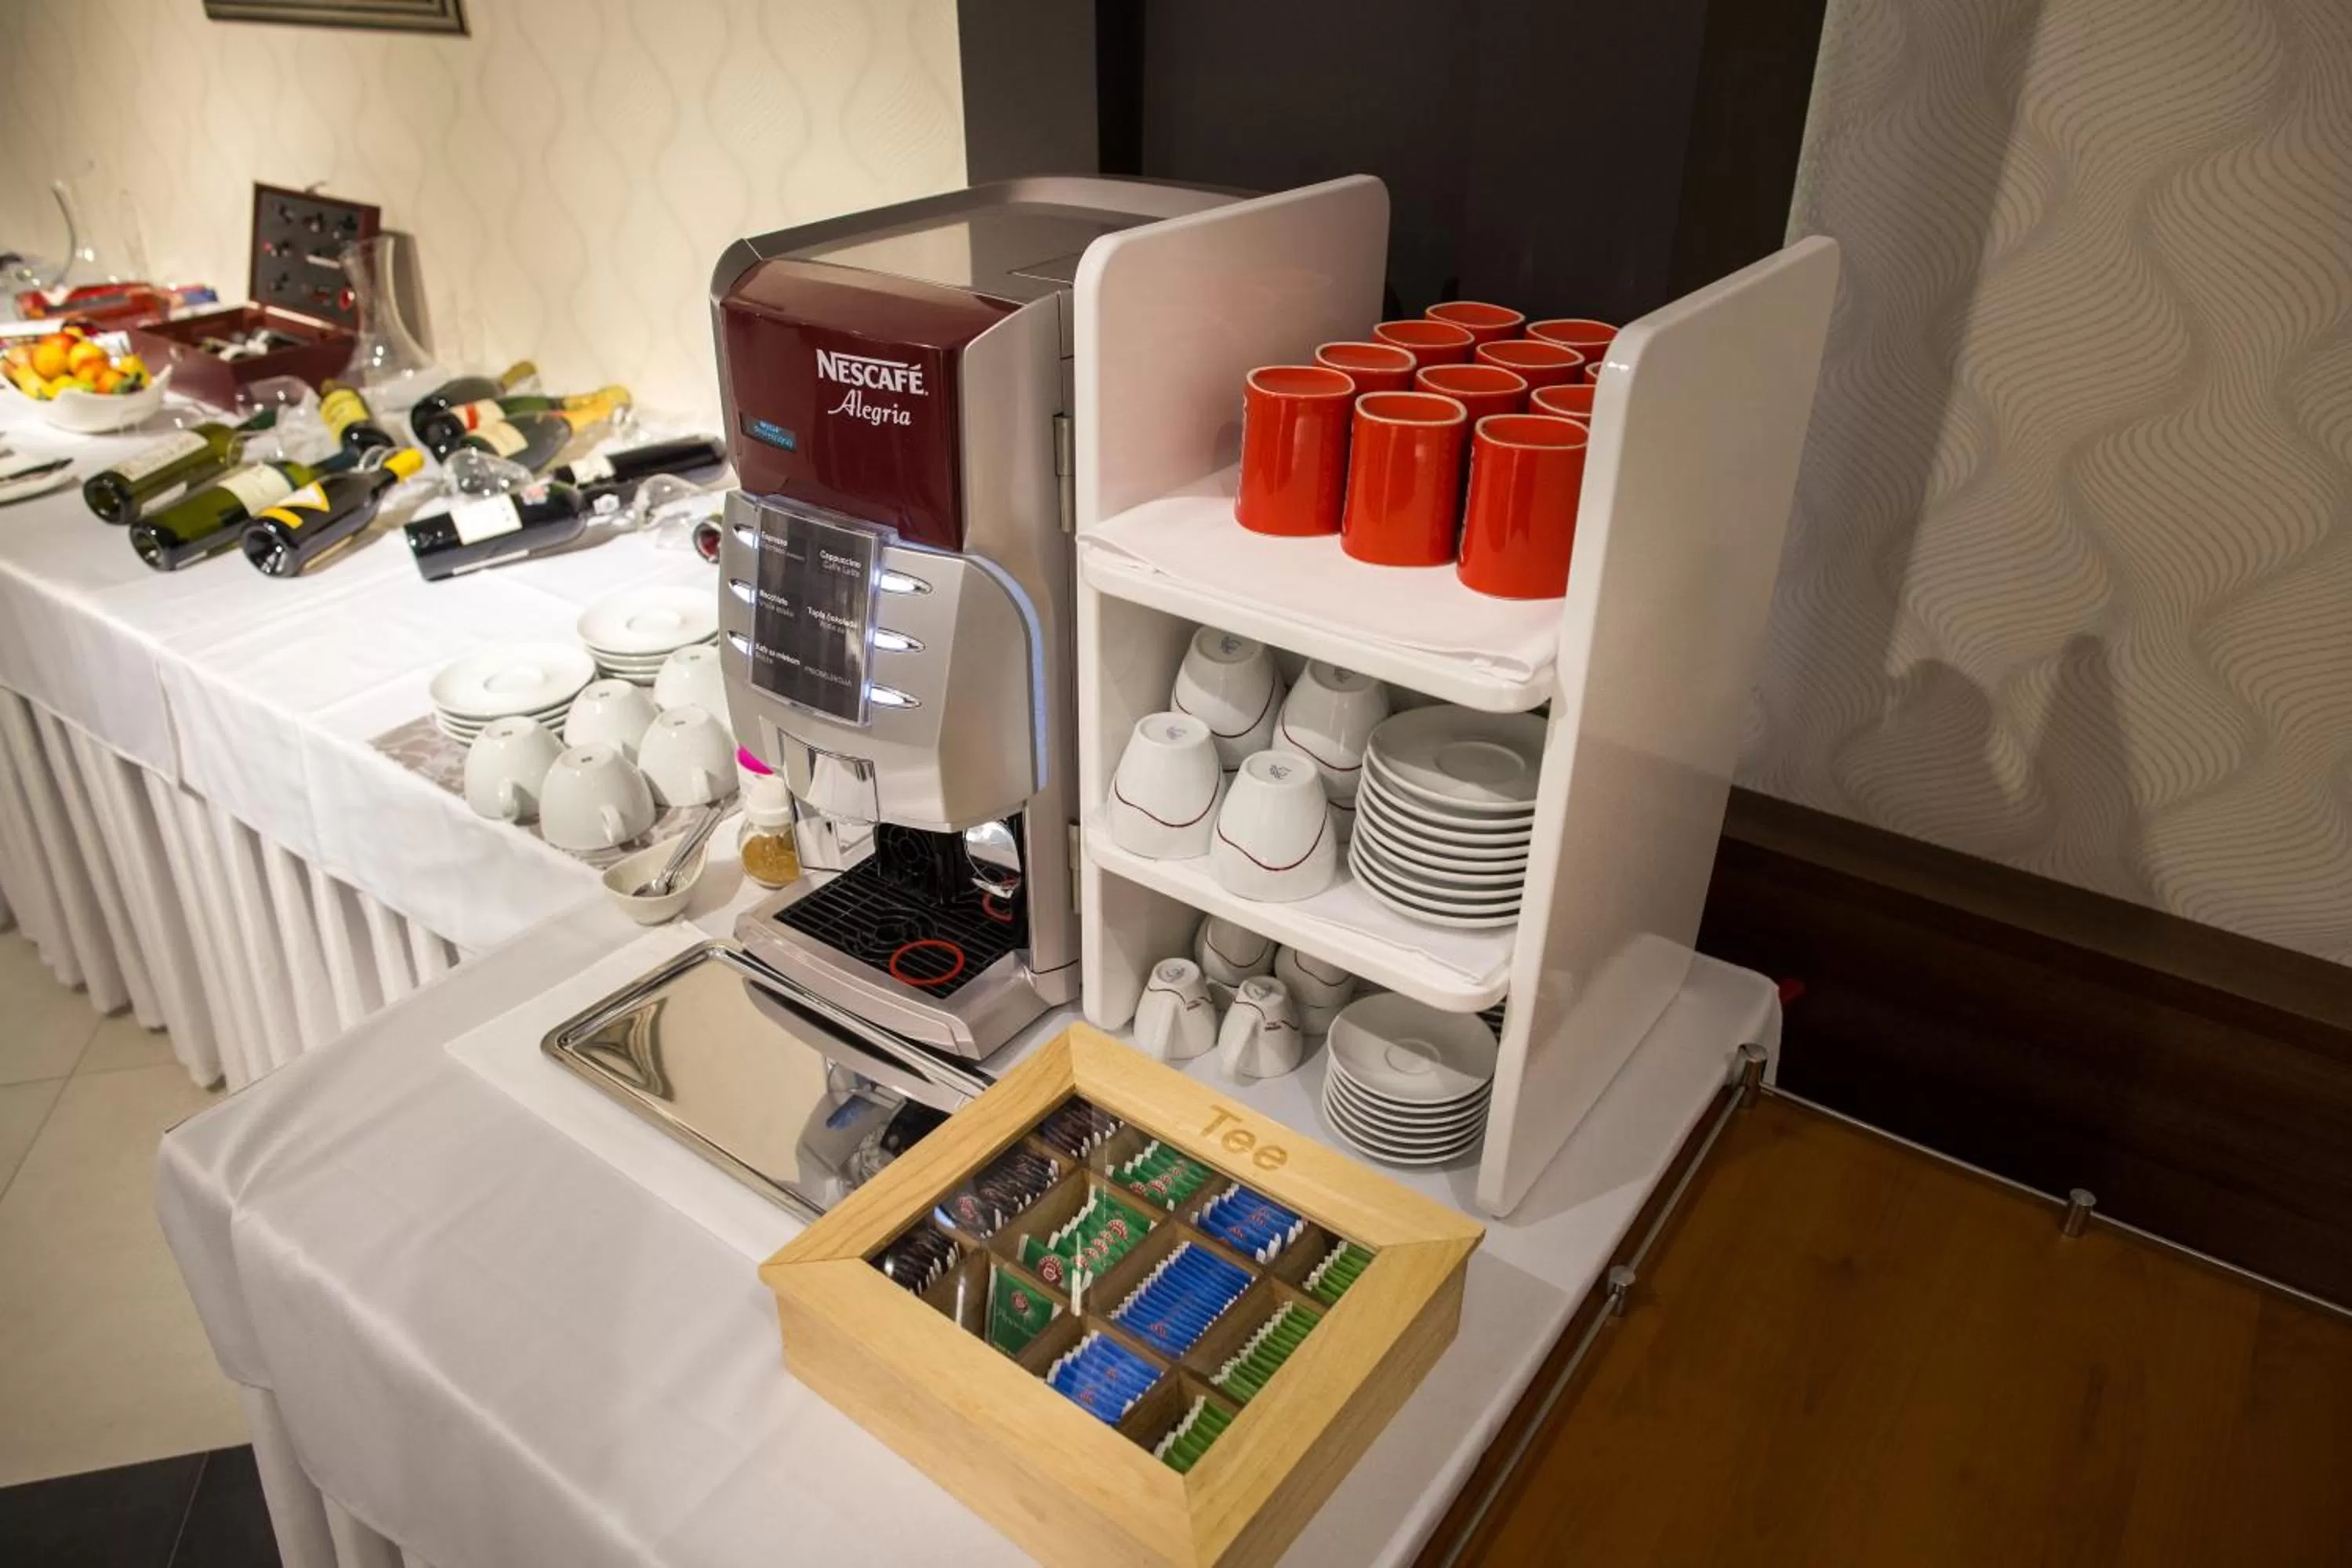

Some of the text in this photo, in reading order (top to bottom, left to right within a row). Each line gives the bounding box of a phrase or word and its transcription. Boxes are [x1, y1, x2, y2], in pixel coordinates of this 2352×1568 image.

[816, 347, 925, 395] NESCAFÉ
[827, 388, 912, 426] Alegria
[819, 549, 862, 569] Cappuccino
[1197, 1104, 1288, 1171] Tee
